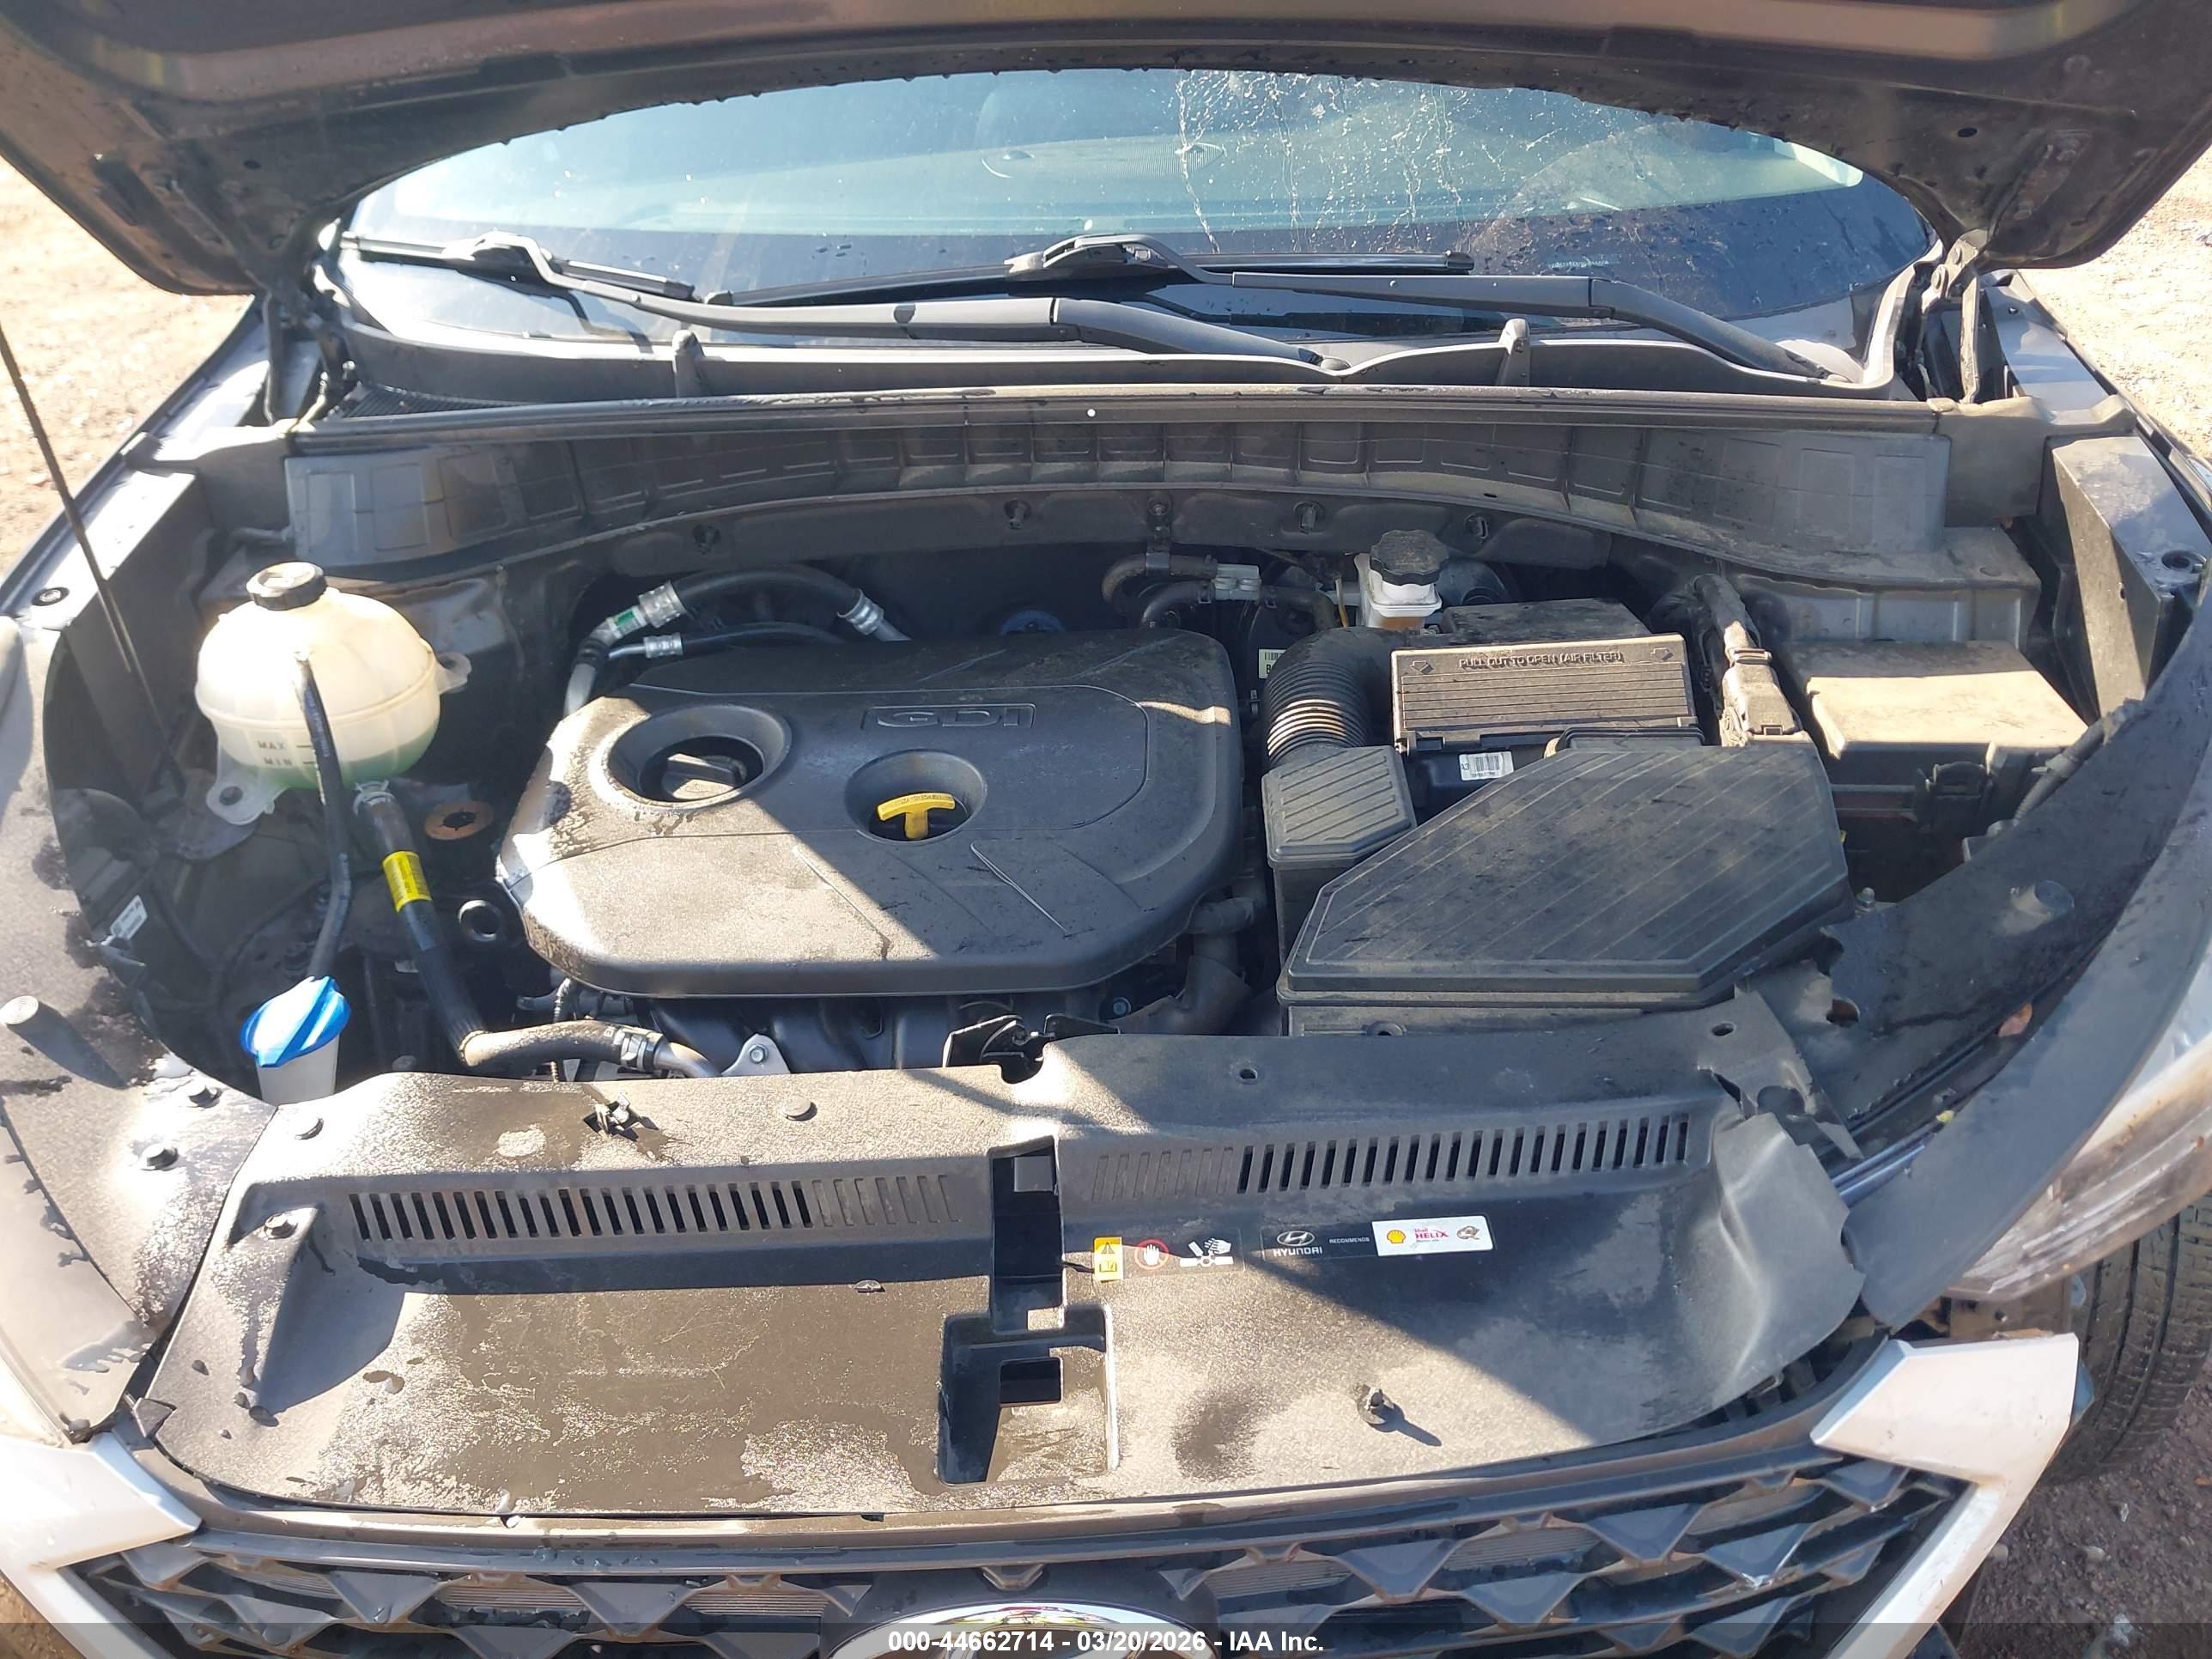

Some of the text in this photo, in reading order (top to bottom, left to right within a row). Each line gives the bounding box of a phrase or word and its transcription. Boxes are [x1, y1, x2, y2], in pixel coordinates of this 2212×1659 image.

[1459, 650, 1624, 668] PULL OUT TO OPEN (AIR FILTER)
[877, 708, 1020, 729] GDI
[258, 741, 285, 750] MAX
[264, 757, 293, 766] MIN
[1415, 1231, 1449, 1240] HELIX
[1273, 1245, 1323, 1258] HYUNDAI
